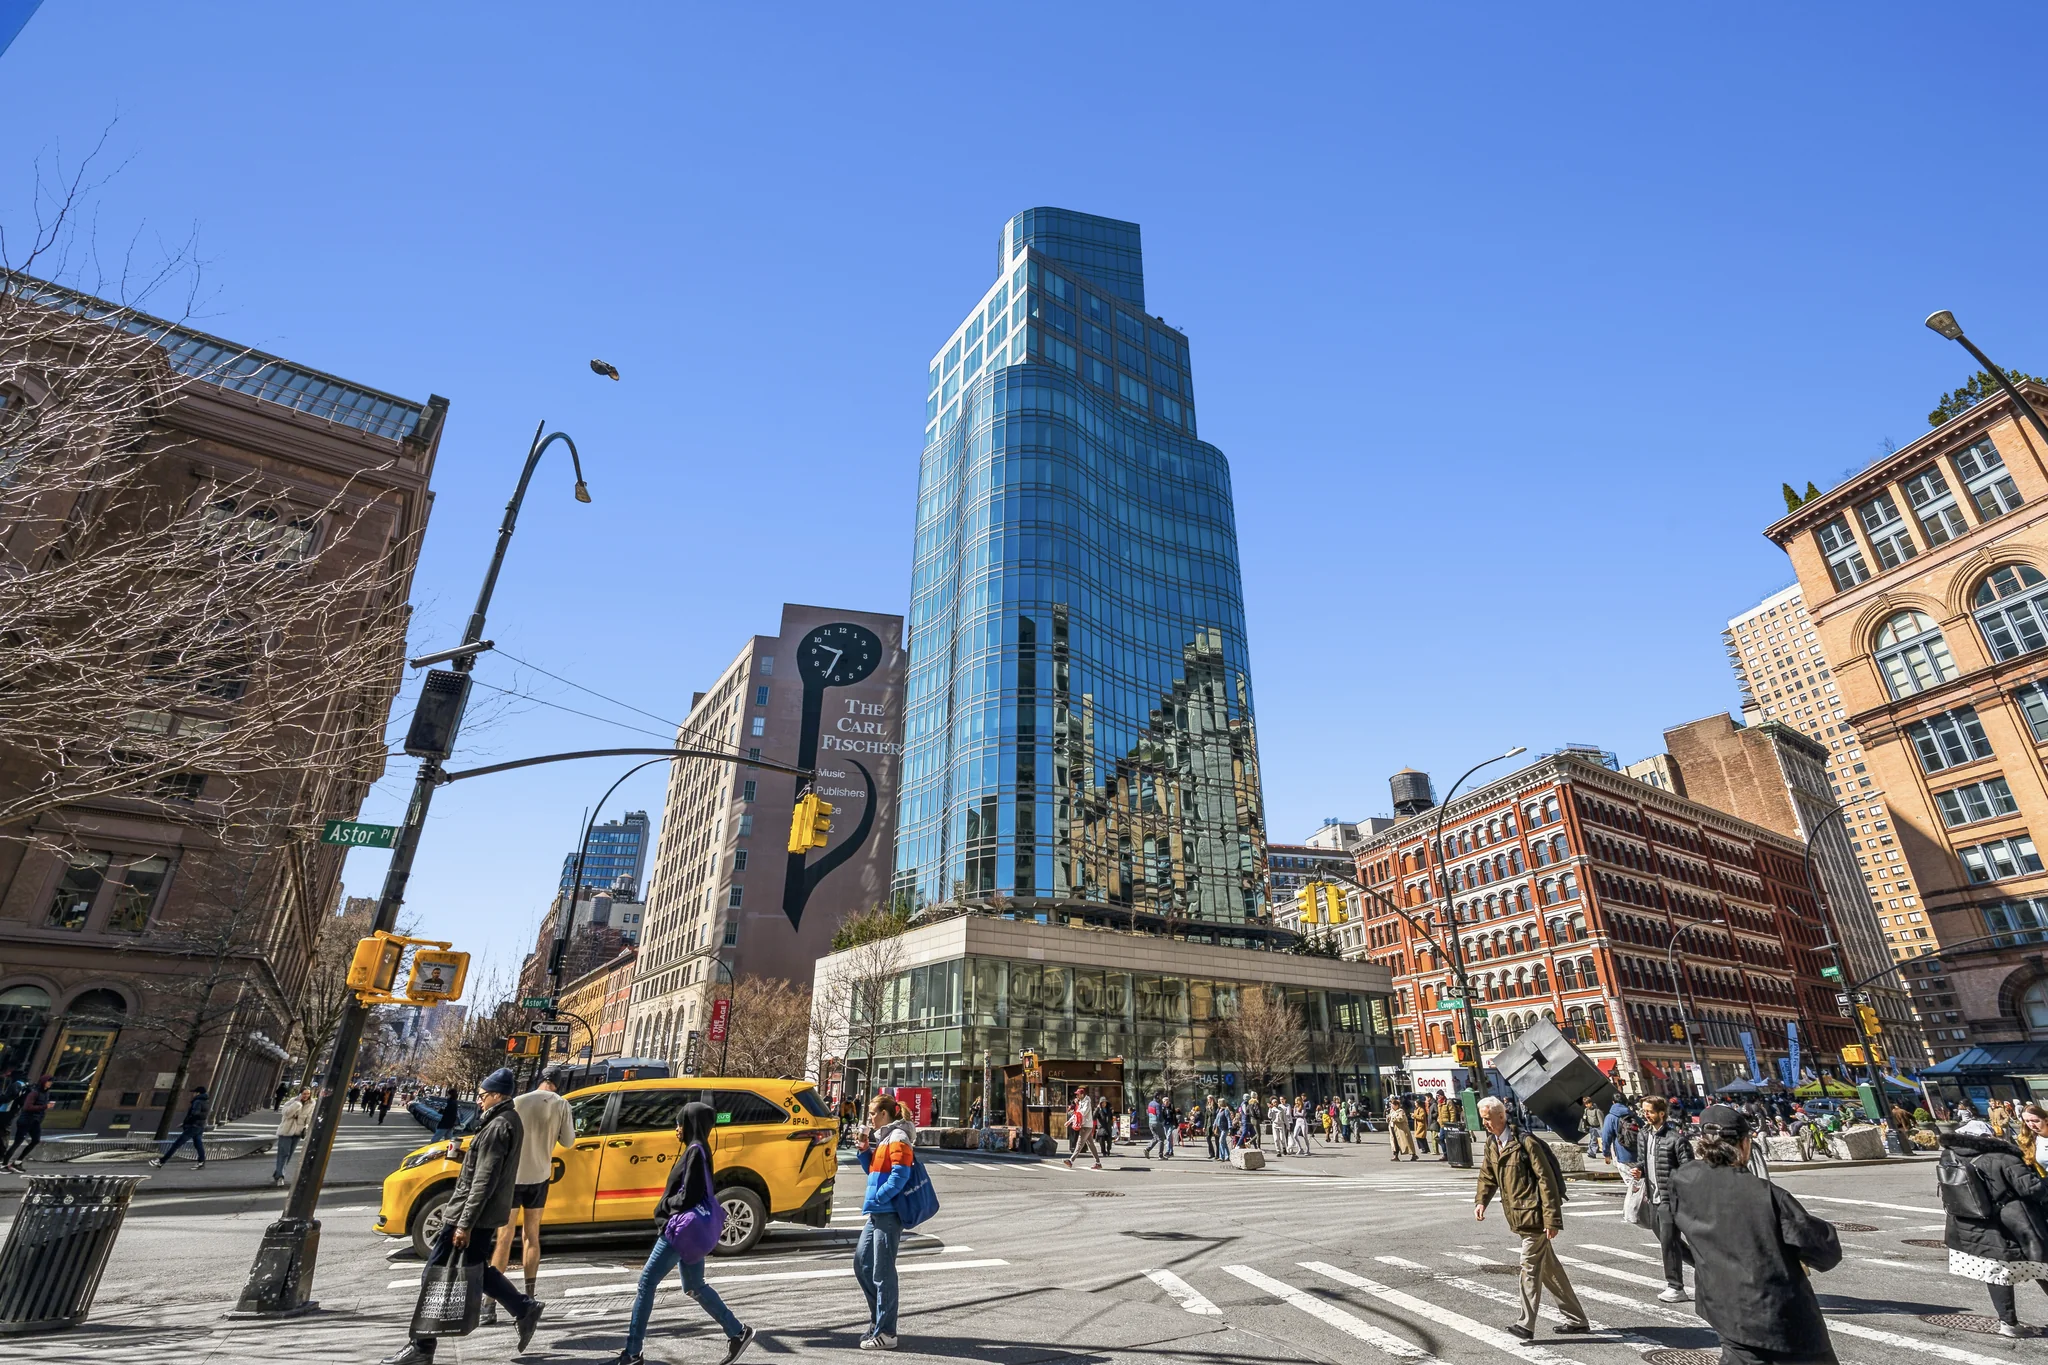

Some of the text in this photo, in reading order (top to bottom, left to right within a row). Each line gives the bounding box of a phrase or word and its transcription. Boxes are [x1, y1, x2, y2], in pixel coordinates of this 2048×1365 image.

[845, 699, 885, 717] THE
[837, 717, 887, 736] CARL
[821, 734, 900, 755] FISCHER
[818, 768, 846, 779] Music
[816, 786, 865, 798] Publishers
[329, 824, 391, 844] Astor Pl
[524, 999, 542, 1007] Astor
[1440, 1001, 1456, 1009] Cooper
[718, 1005, 727, 1034] VILLAGE
[712, 1019, 720, 1034] THE
[687, 1039, 697, 1065] PARK
[920, 1070, 943, 1081] CASE
[1195, 1074, 1225, 1084] HASE
[1417, 1077, 1446, 1088] Gordon
[914, 1093, 922, 1127] VILLAGE
[424, 1296, 466, 1304] THANK YOU
